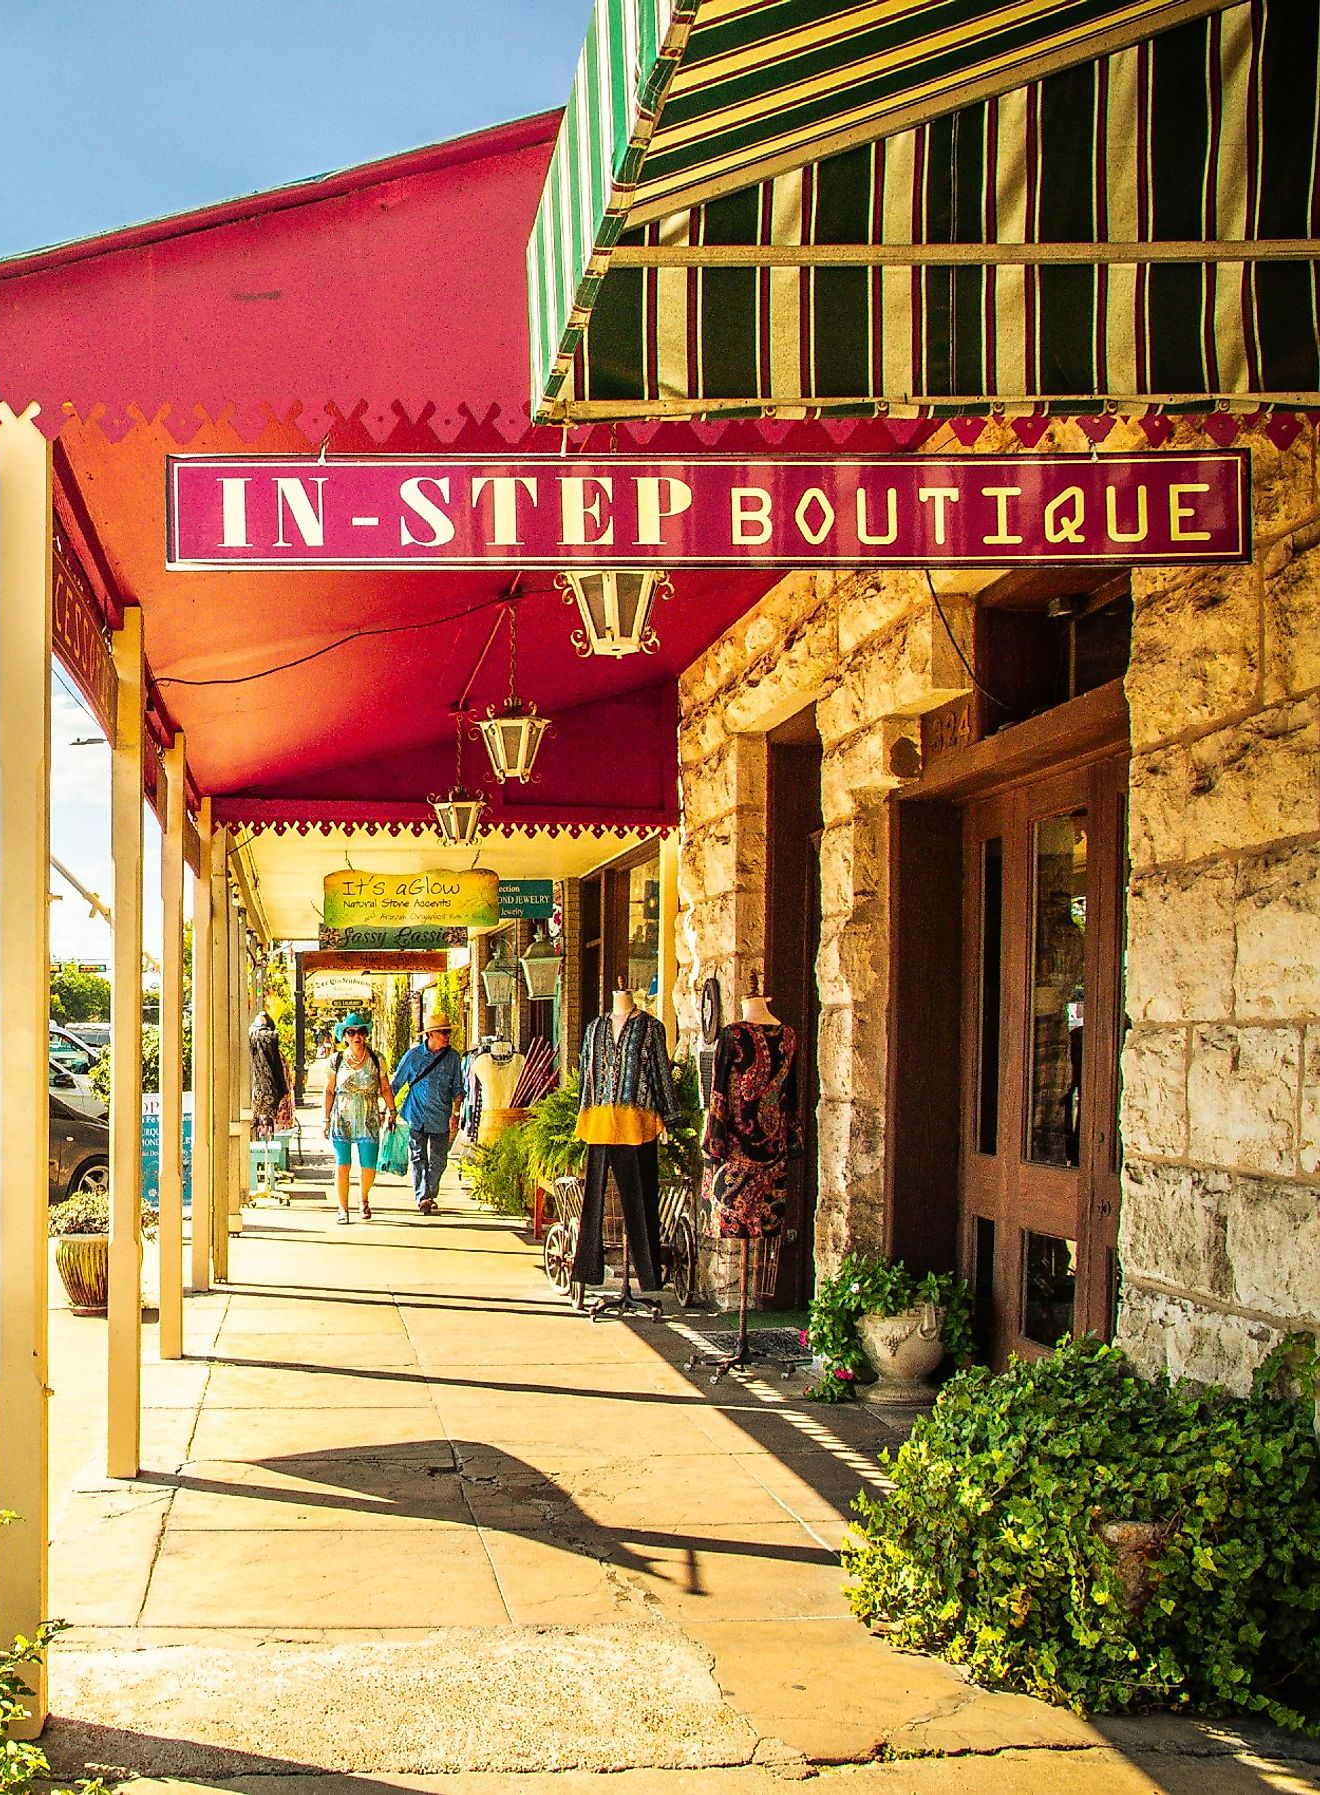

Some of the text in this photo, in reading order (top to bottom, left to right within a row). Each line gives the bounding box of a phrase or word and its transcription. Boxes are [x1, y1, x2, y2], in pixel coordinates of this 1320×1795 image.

[215, 476, 1211, 547] IN-STEP BOUTIQUE
[342, 876, 460, 896] It's aGlow
[497, 885, 520, 893] ection
[343, 898, 452, 908] Natural Stone Accents
[515, 895, 550, 904] JEWELRY
[339, 927, 387, 948] Sassy
